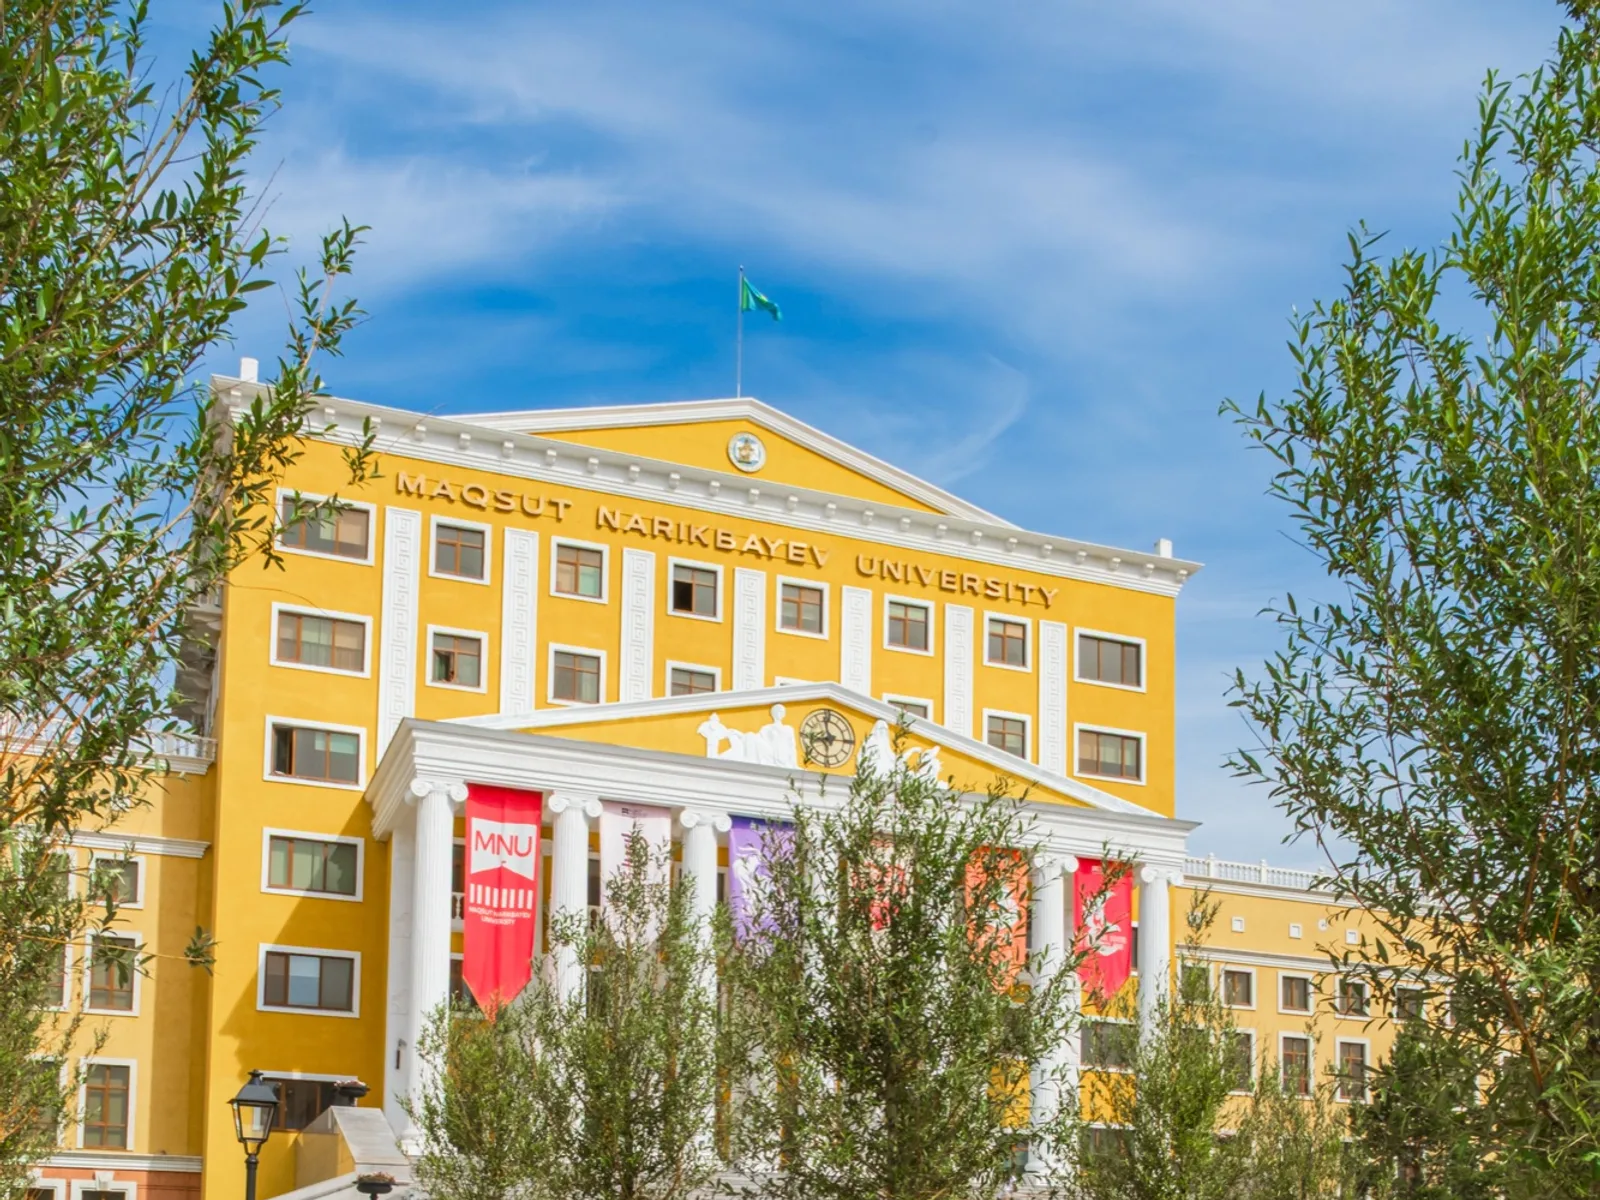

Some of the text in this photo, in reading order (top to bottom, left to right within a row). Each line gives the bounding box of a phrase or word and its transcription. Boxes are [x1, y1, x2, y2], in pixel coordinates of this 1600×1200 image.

[397, 471, 1059, 609] MAQSUT NARIKBAYEV UNIVERSITY
[475, 830, 533, 857] MNU
